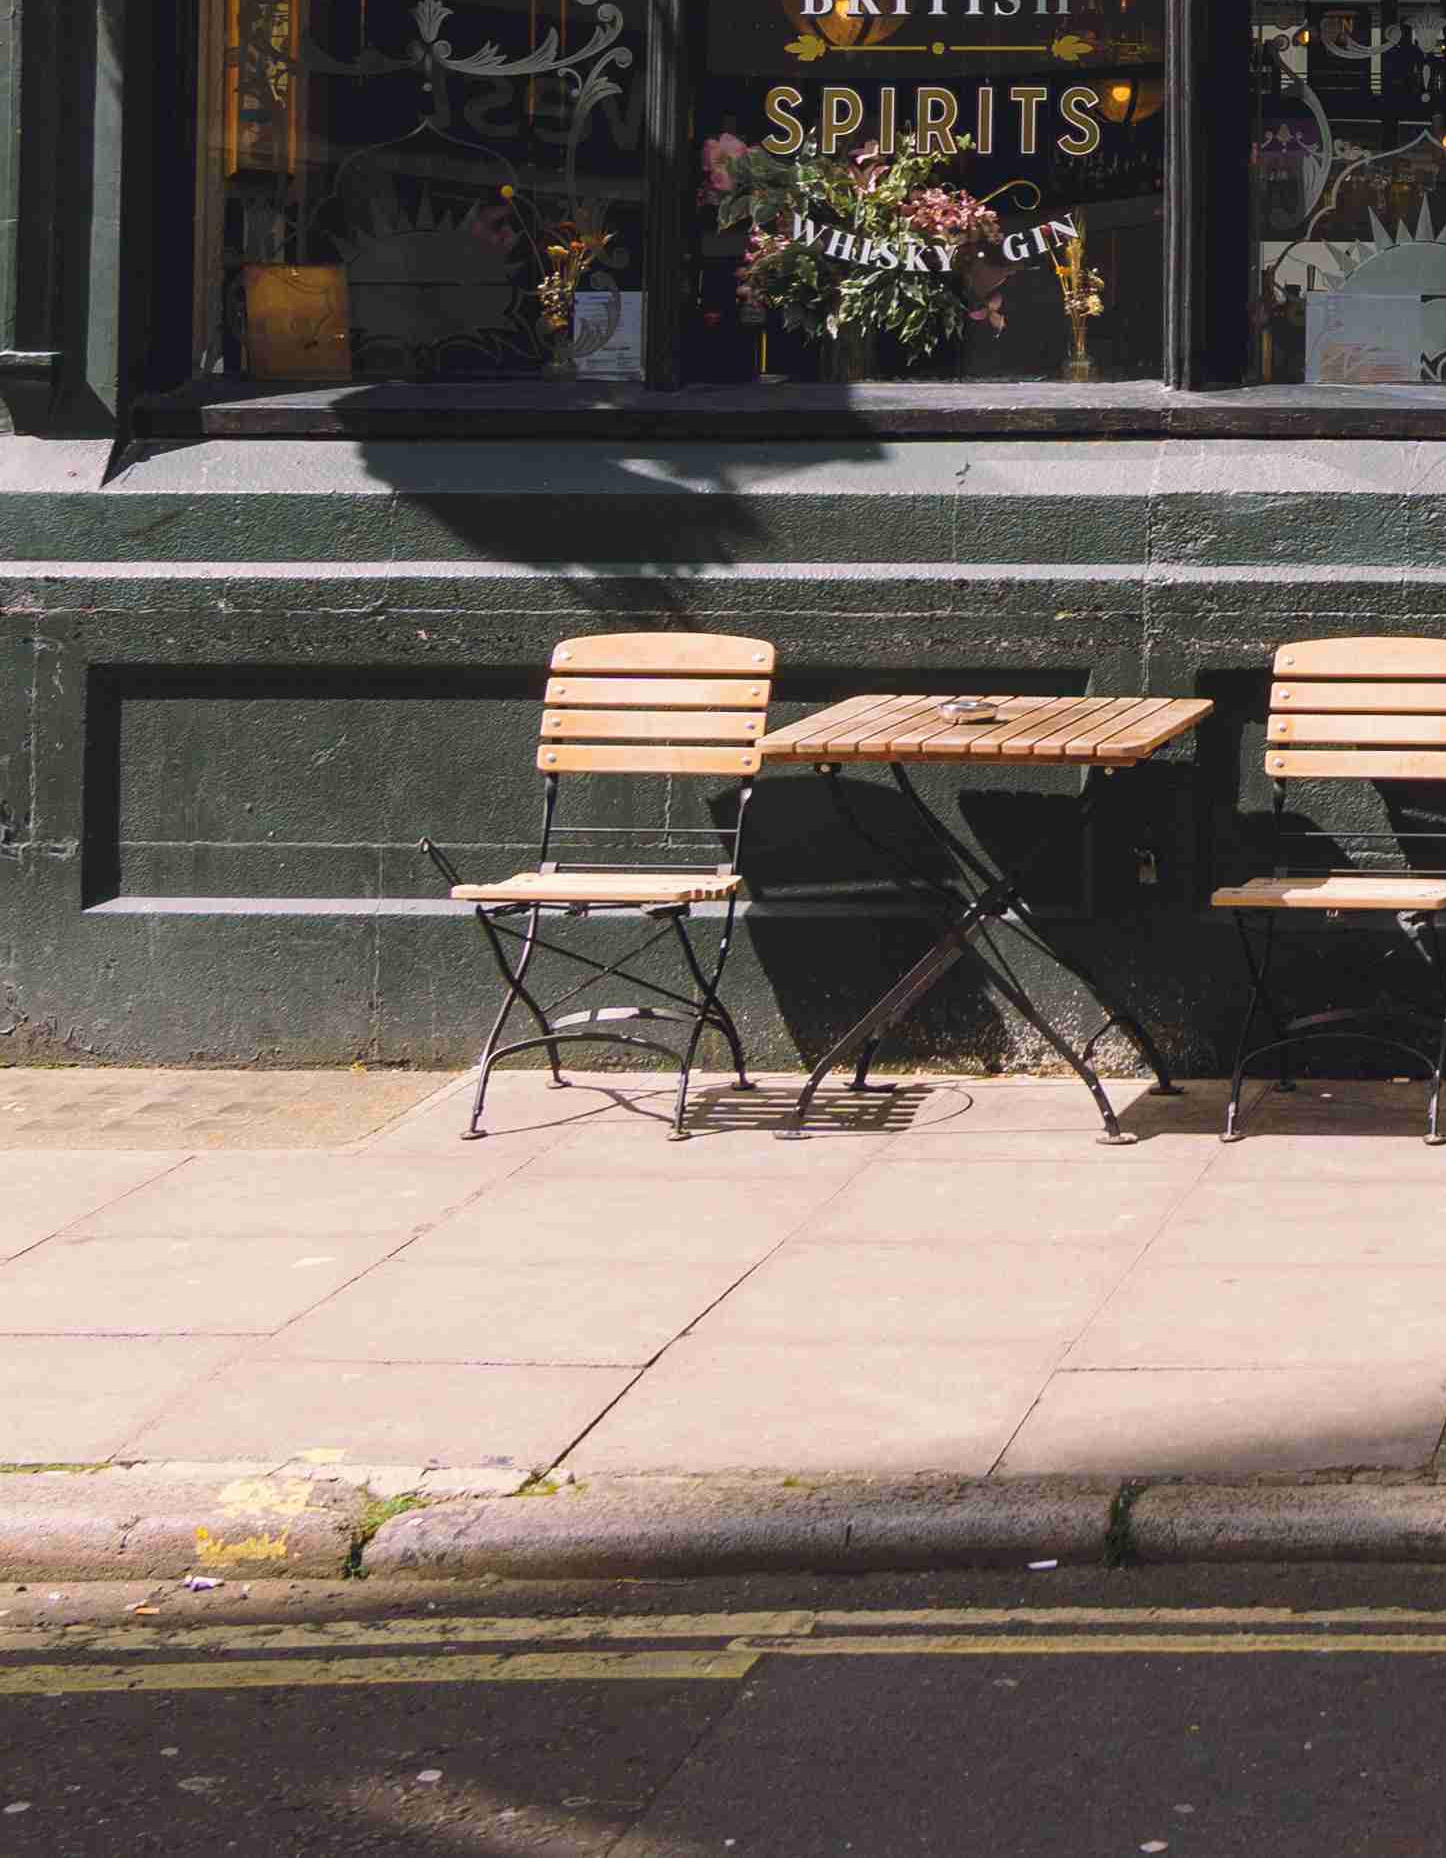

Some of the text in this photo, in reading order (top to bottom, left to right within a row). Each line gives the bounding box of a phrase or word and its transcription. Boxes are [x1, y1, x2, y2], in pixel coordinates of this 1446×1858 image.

[762, 86, 1102, 155] SPIRITS
[792, 211, 1080, 272] WHISKY GIN
